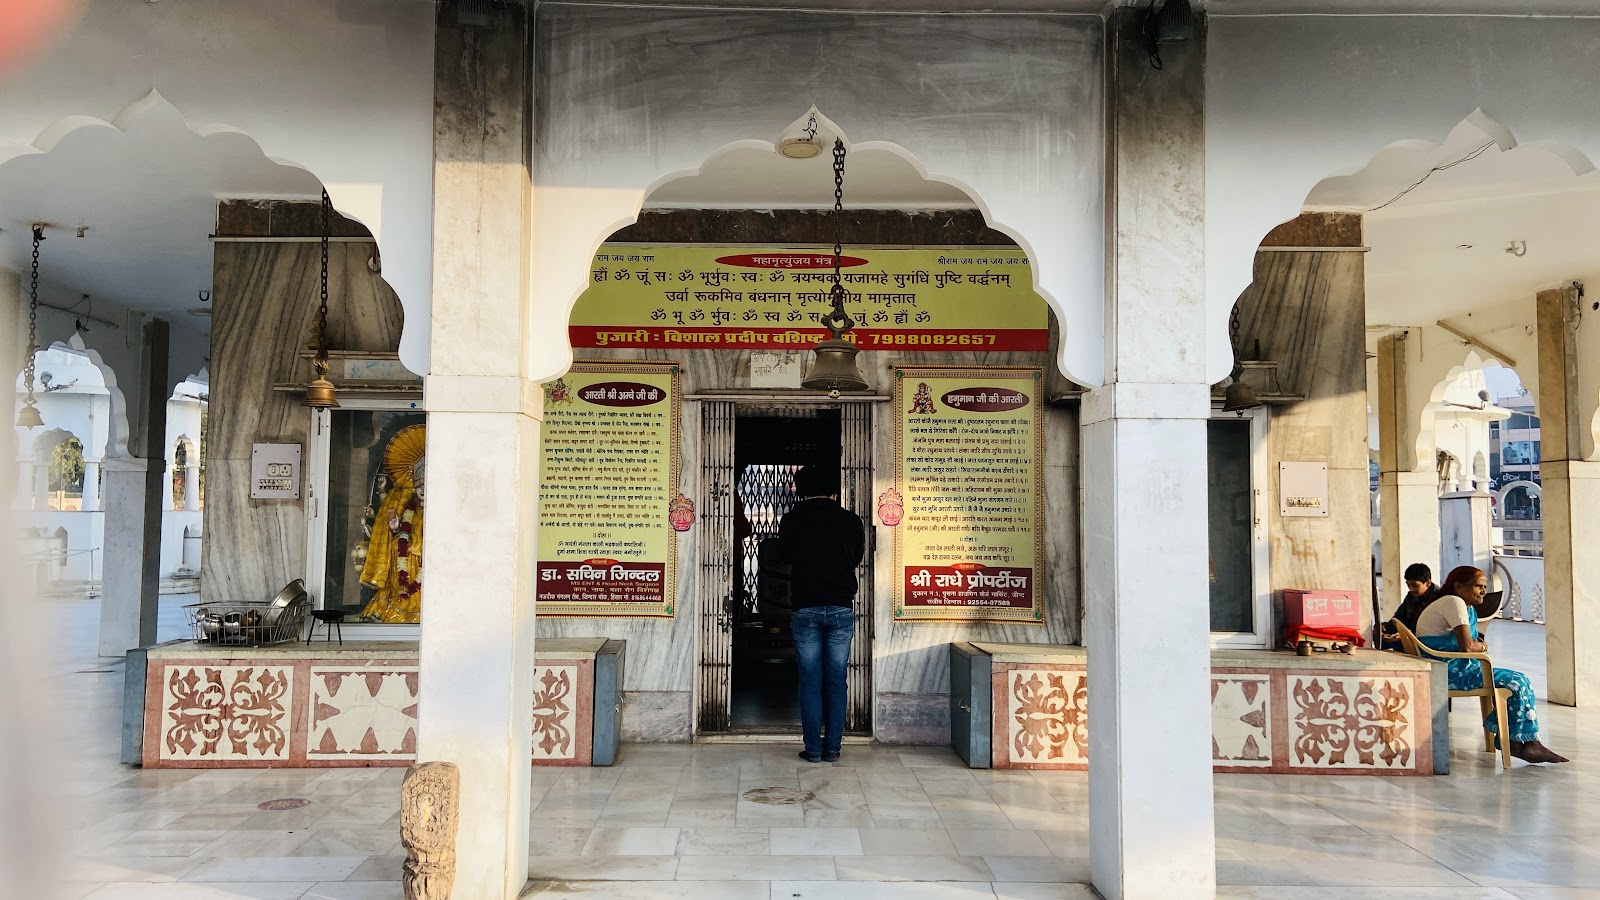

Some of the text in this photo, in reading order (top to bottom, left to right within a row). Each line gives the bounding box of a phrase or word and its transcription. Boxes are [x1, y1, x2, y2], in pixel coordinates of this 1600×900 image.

[752, 256, 832, 267] महामृत्युंजय मंत्र
[938, 256, 957, 264] श्रीराम
[614, 268, 630, 280] ॐ
[635, 268, 652, 285] जूं
[678, 269, 694, 281] ॐ
[769, 270, 785, 282] ॐ
[843, 270, 888, 285] यजामहे
[934, 270, 962, 288] पुष्टि
[967, 270, 1011, 288] वर्द्धनम्
[664, 288, 689, 302] उर्वा
[694, 288, 743, 302] रूकमिव
[748, 289, 792, 306] बंधनान्
[867, 293, 917, 307] मामृतात्
[651, 308, 666, 320] ॐ
[673, 311, 685, 325] भू
[689, 308, 705, 321] ॐ
[742, 309, 758, 321] ॐ
[763, 311, 780, 322] स्व
[787, 309, 802, 322] ॐ
[853, 310, 868, 326] जूं
[873, 310, 888, 322] ॐ
[915, 311, 930, 322] ॐ
[596, 330, 650, 345] पुजारी
[664, 330, 722, 343] विशाल
[724, 330, 770, 343] प्रदीप
[869, 334, 996, 345] 7988082657
[585, 388, 658, 400] आरती श्री अम्बे जी की
[947, 392, 1023, 406] हनुमान जी की आरती
[541, 565, 661, 581] डा. सचिन जिन्दल
[910, 569, 1027, 589] श्री राधे प्रोपर्टीज
